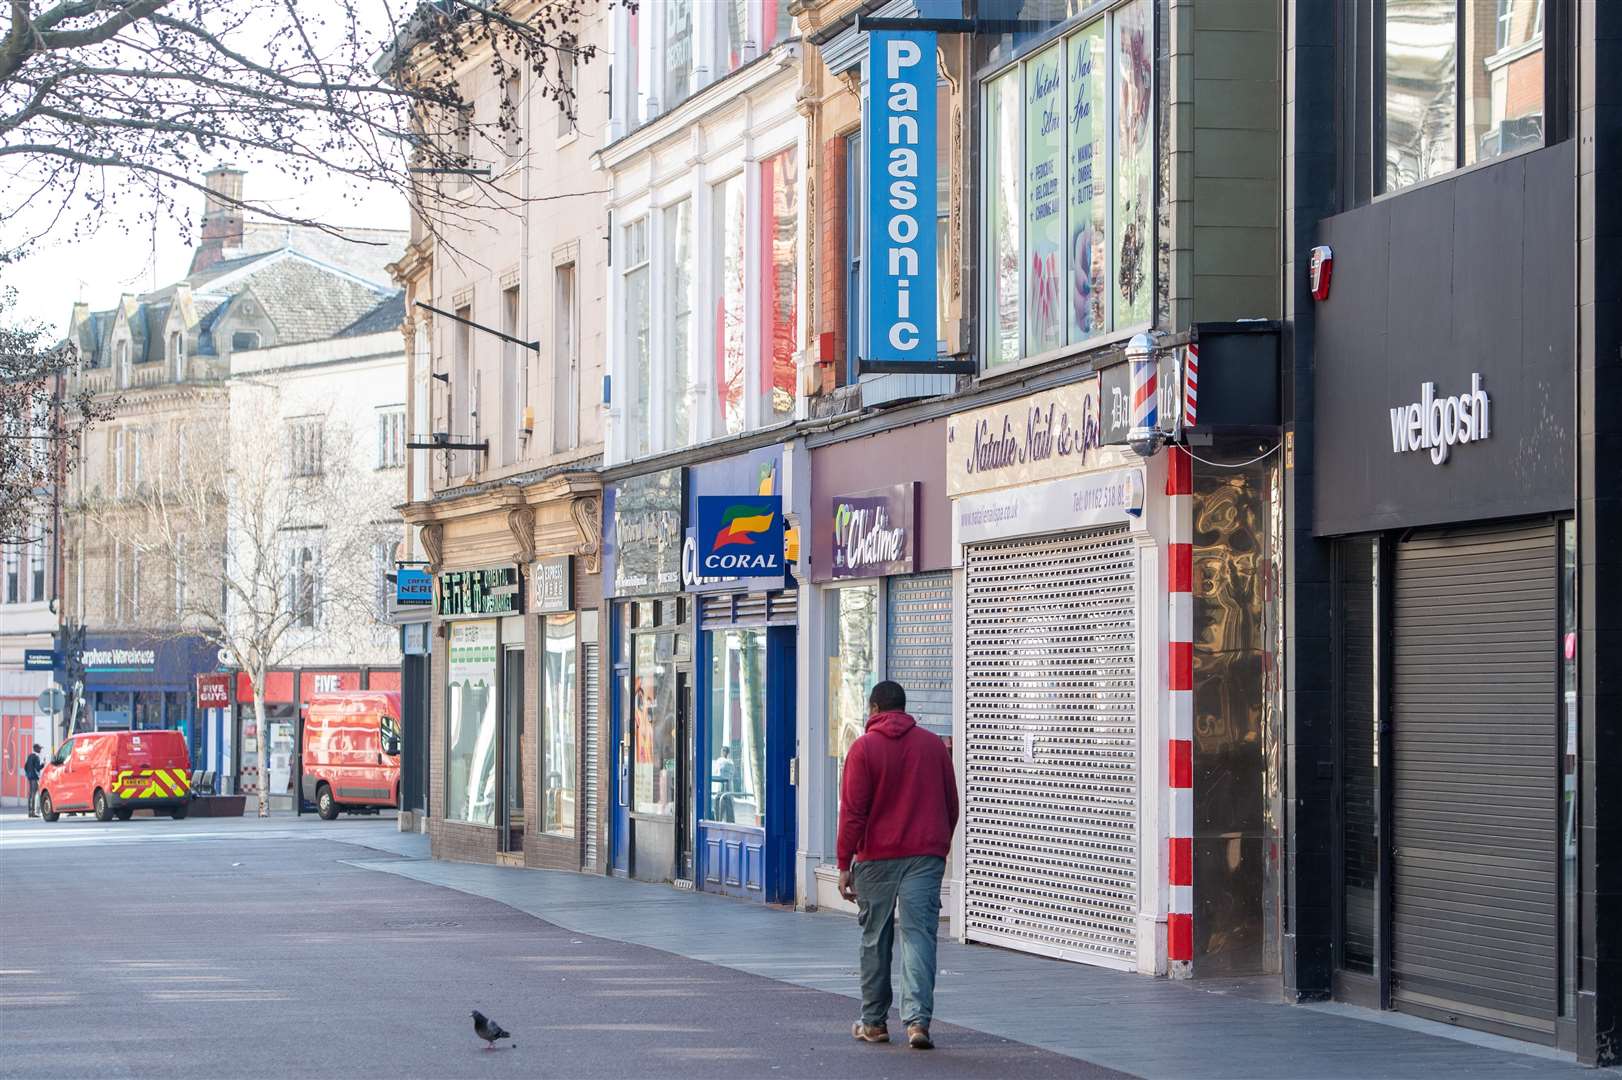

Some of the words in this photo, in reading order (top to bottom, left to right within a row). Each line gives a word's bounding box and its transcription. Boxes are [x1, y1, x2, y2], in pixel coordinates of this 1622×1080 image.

[887, 39, 921, 351] Panasonic
[966, 414, 1018, 474] Natalie
[1018, 402, 1056, 465] Nail
[1057, 412, 1073, 457] &
[1390, 372, 1489, 466] wellgosh
[846, 505, 904, 569] Chatime
[704, 553, 778, 569] CORAL
[200, 692, 228, 701] GUYS
[202, 684, 226, 693] FIVE
[314, 674, 338, 693] FIVE
